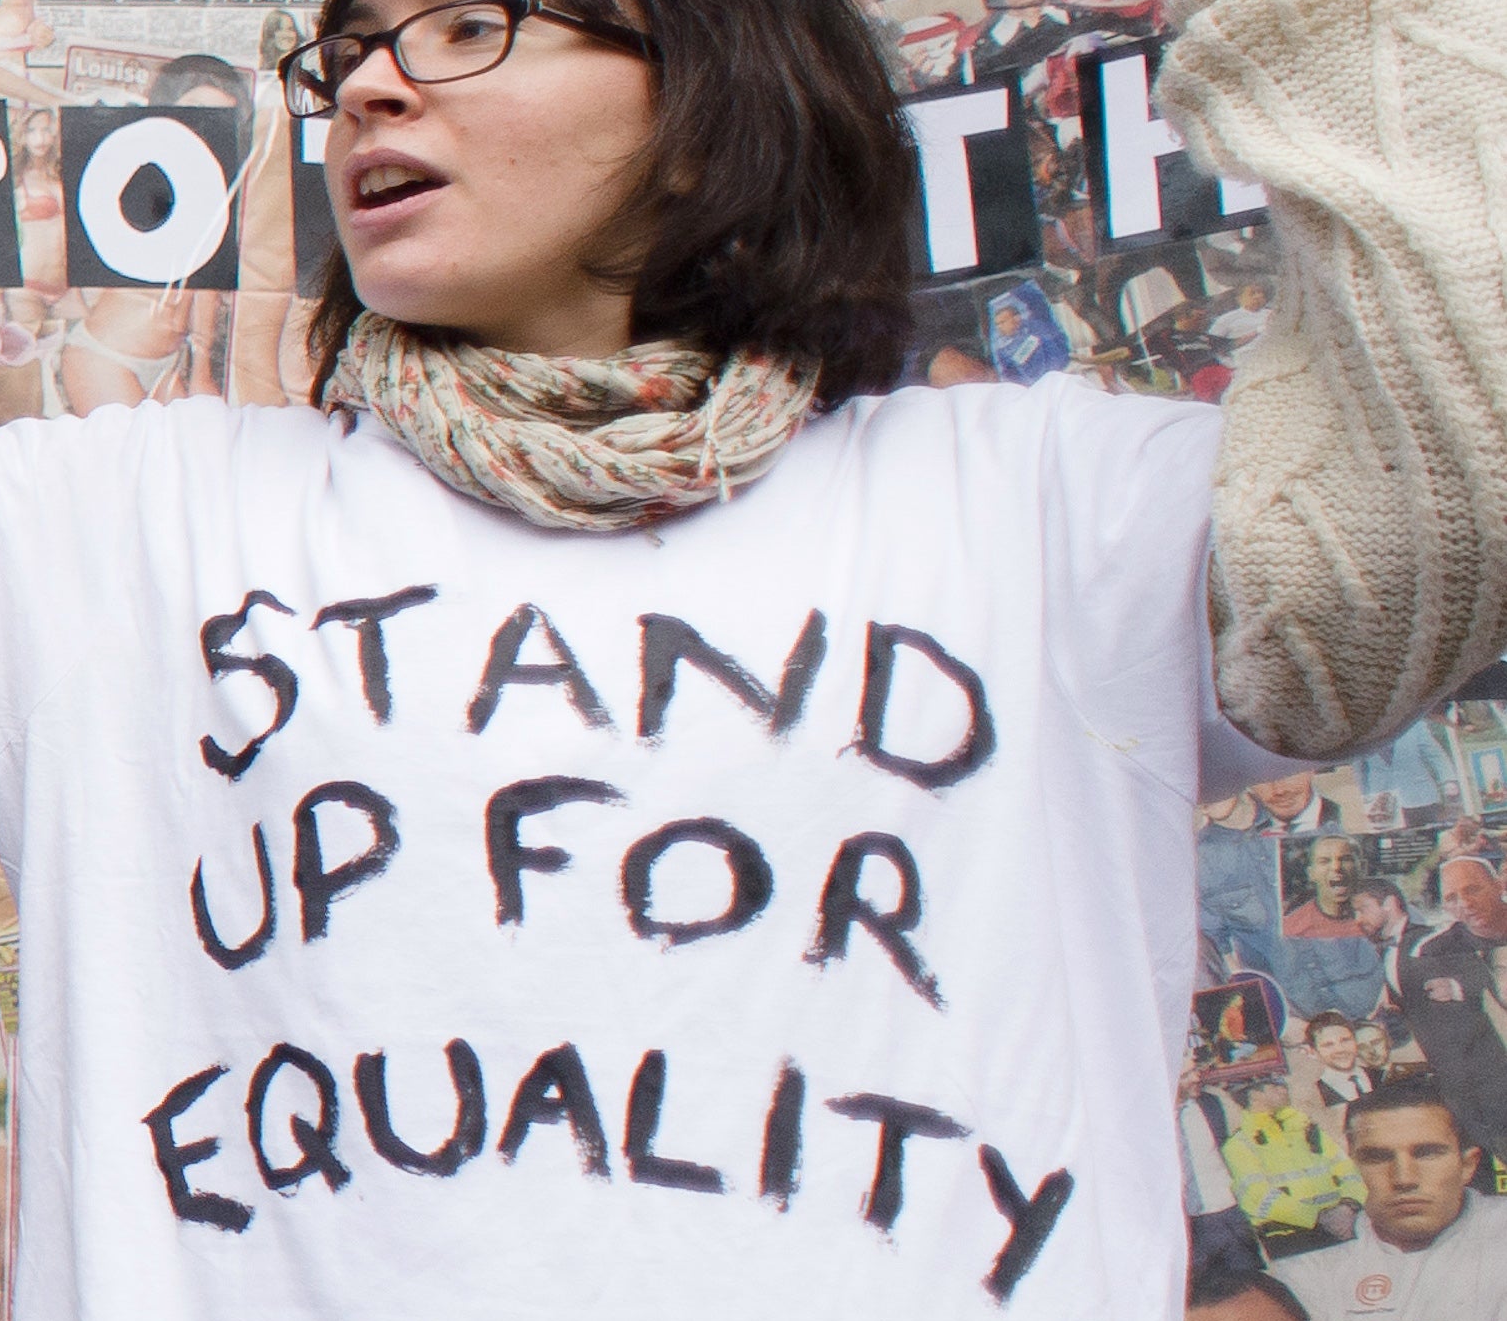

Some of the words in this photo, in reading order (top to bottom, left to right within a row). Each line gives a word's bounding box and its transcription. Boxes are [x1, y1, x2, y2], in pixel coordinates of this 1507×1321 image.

[199, 584, 997, 795] STAND
[189, 780, 401, 971] UP
[485, 774, 949, 1012] FOR
[143, 1037, 1075, 1308] EQUALITY
